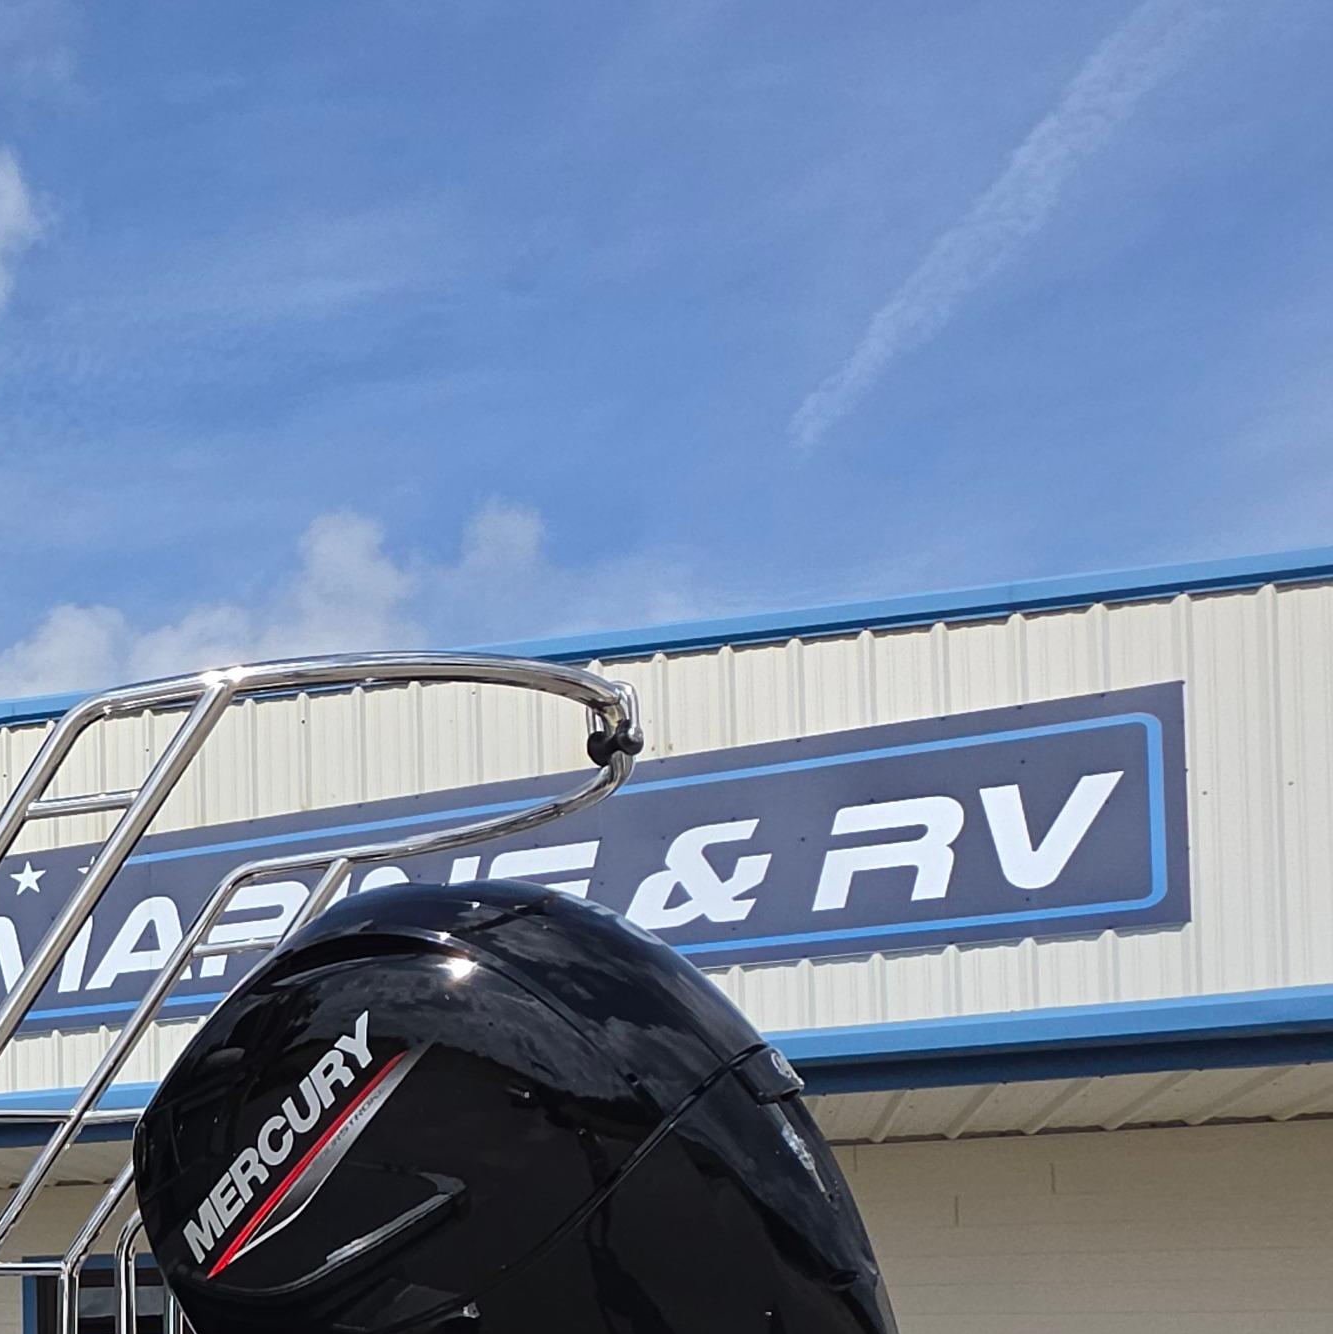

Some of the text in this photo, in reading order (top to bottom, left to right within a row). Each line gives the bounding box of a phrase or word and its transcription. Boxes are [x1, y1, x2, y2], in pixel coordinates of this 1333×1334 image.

[626, 819, 772, 930] &
[812, 771, 1125, 912] RV
[183, 1010, 373, 1264] MERCURY
